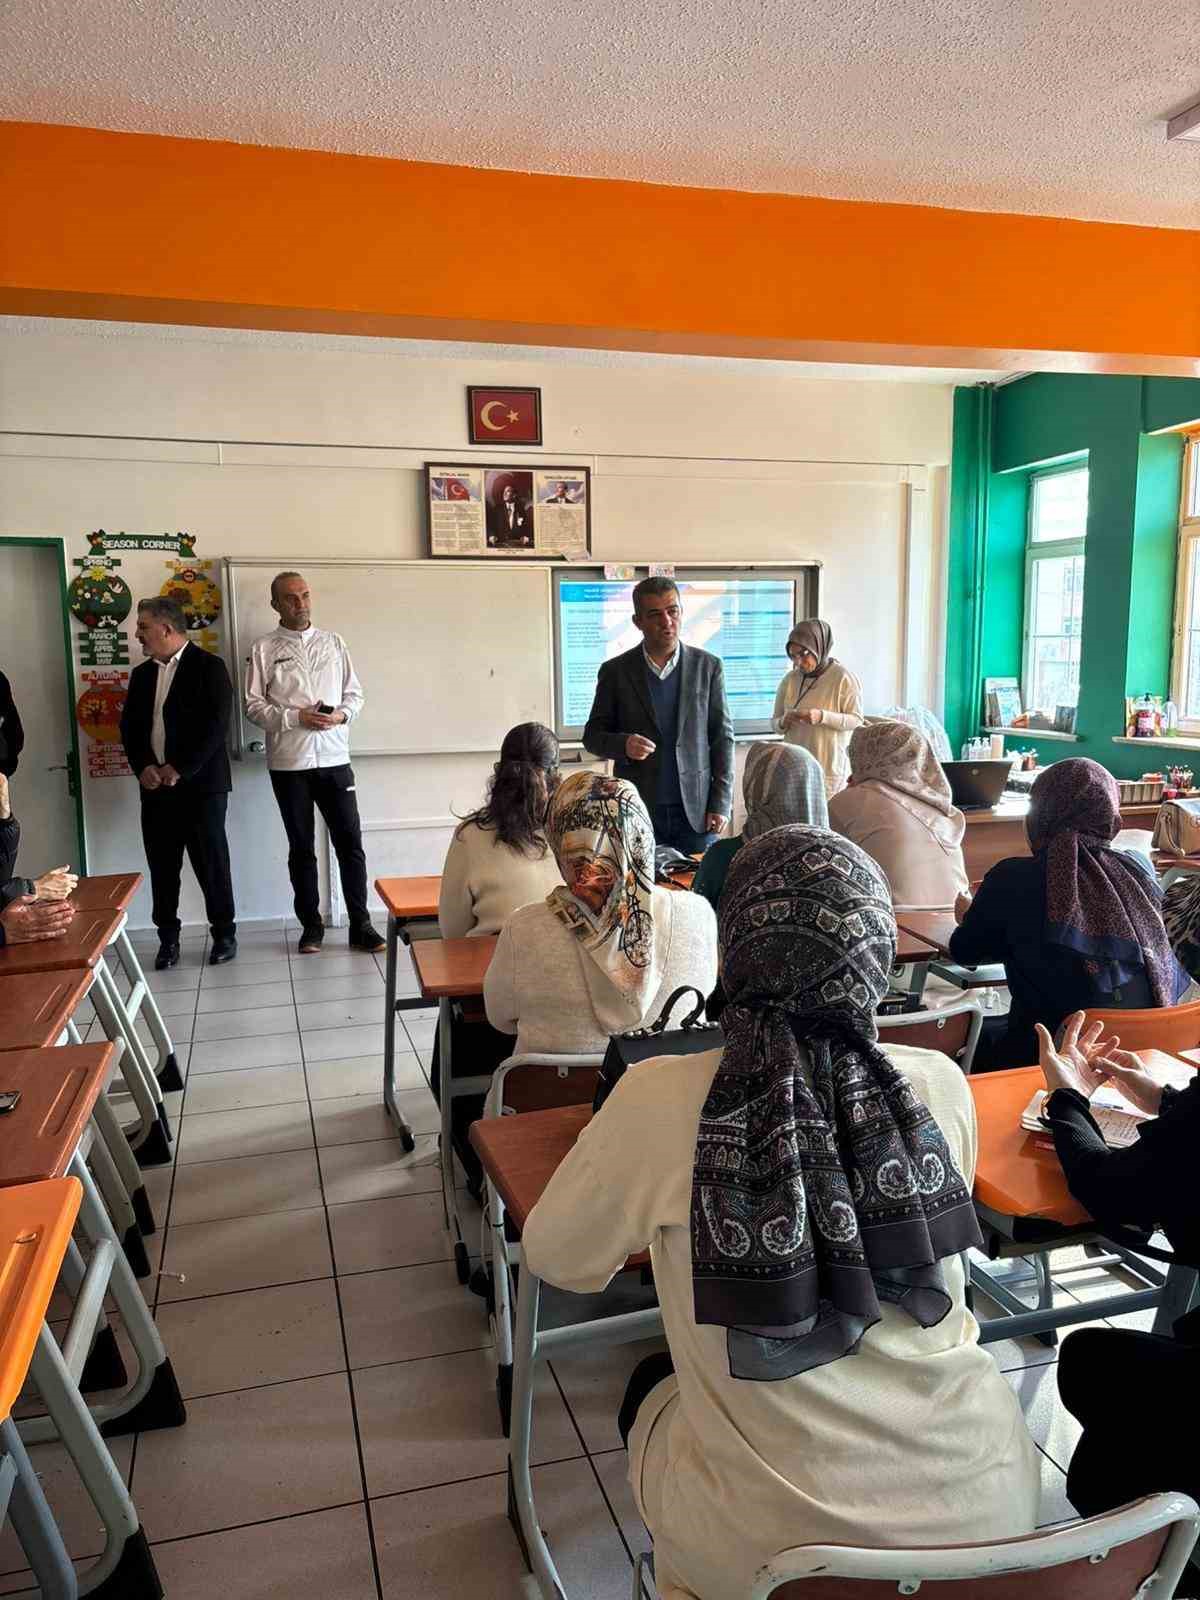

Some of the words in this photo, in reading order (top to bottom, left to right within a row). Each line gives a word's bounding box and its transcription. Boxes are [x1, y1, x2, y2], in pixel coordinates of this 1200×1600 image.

[102, 539, 138, 548] SEASON
[142, 539, 181, 550] CORNER
[88, 632, 118, 640] MARCH
